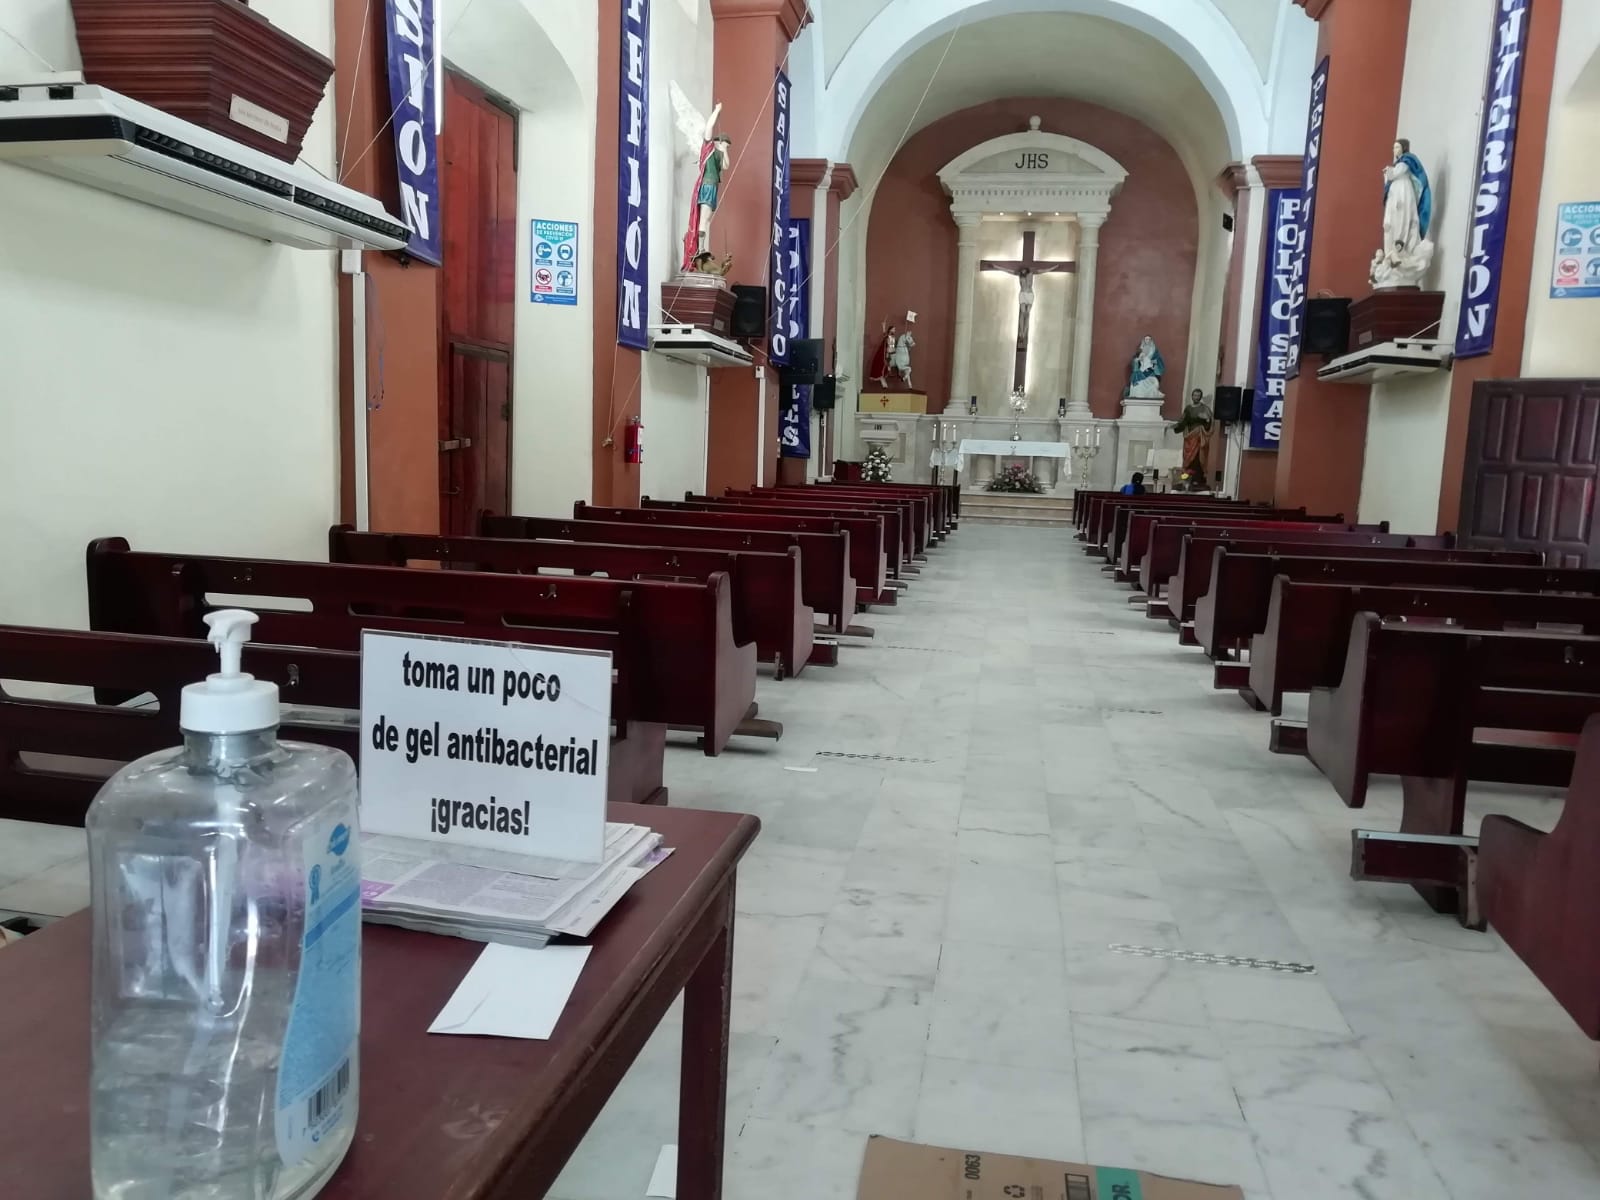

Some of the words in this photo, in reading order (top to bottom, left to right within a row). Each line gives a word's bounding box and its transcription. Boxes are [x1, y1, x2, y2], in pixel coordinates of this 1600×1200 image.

[1015, 153, 1049, 169] JHS
[1463, 0, 1526, 340] NVERSIÓN
[536, 222, 574, 232] ACCIONES
[402, 651, 459, 691] toma
[467, 665, 495, 695] un
[502, 671, 561, 706] poco
[372, 715, 399, 752] de
[406, 721, 440, 763] gel
[446, 727, 598, 776] antibacterial
[430, 796, 531, 836] ¡gracias!
[965, 1154, 981, 1180] 0063
